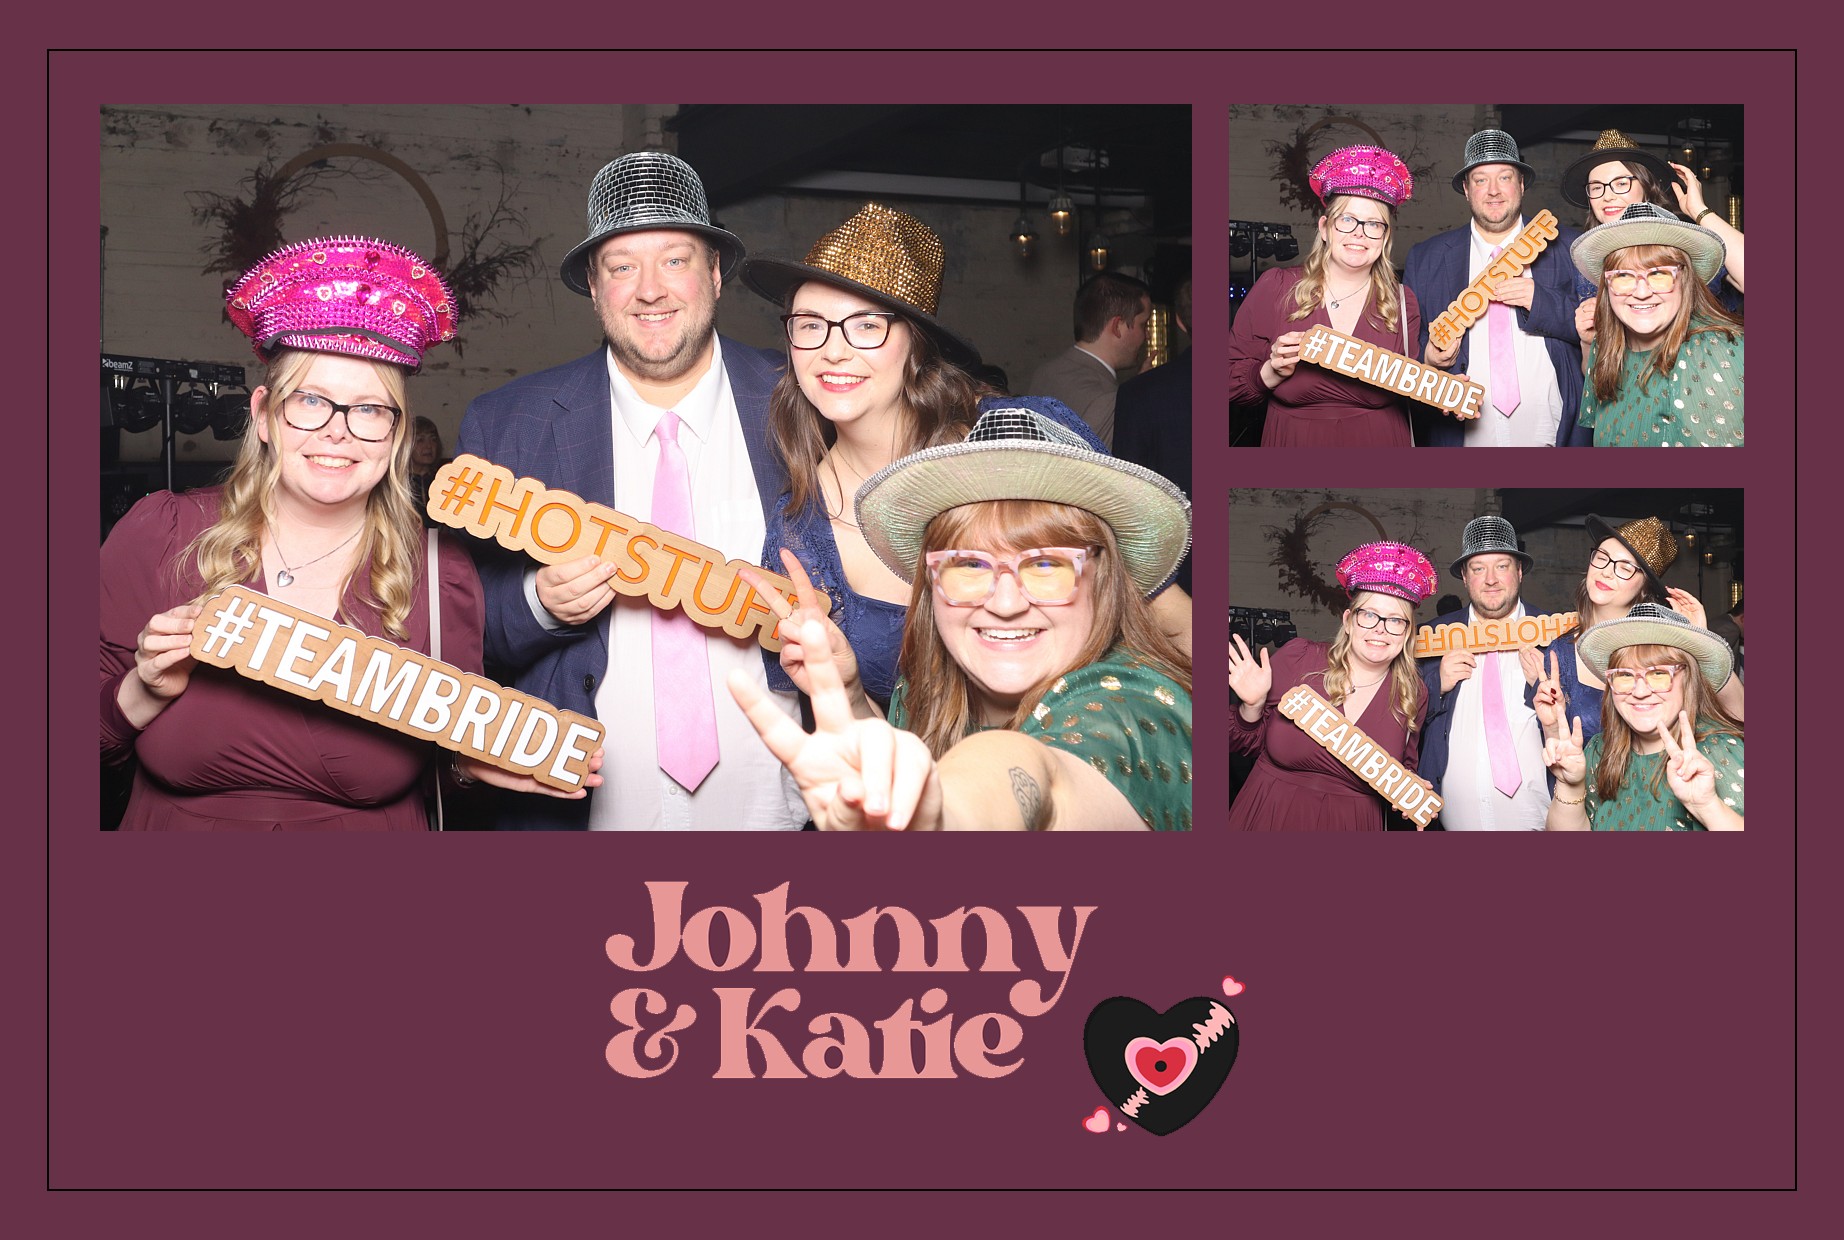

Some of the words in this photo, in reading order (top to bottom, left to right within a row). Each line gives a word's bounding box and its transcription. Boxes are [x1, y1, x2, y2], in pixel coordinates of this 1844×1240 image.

[1433, 213, 1554, 345] #HOTSTUFF
[1303, 329, 1482, 416] #TEAMBRIDE
[201, 597, 600, 786] #TEAMBRIDE
[1284, 689, 1442, 825] #TEAMBRIDE
